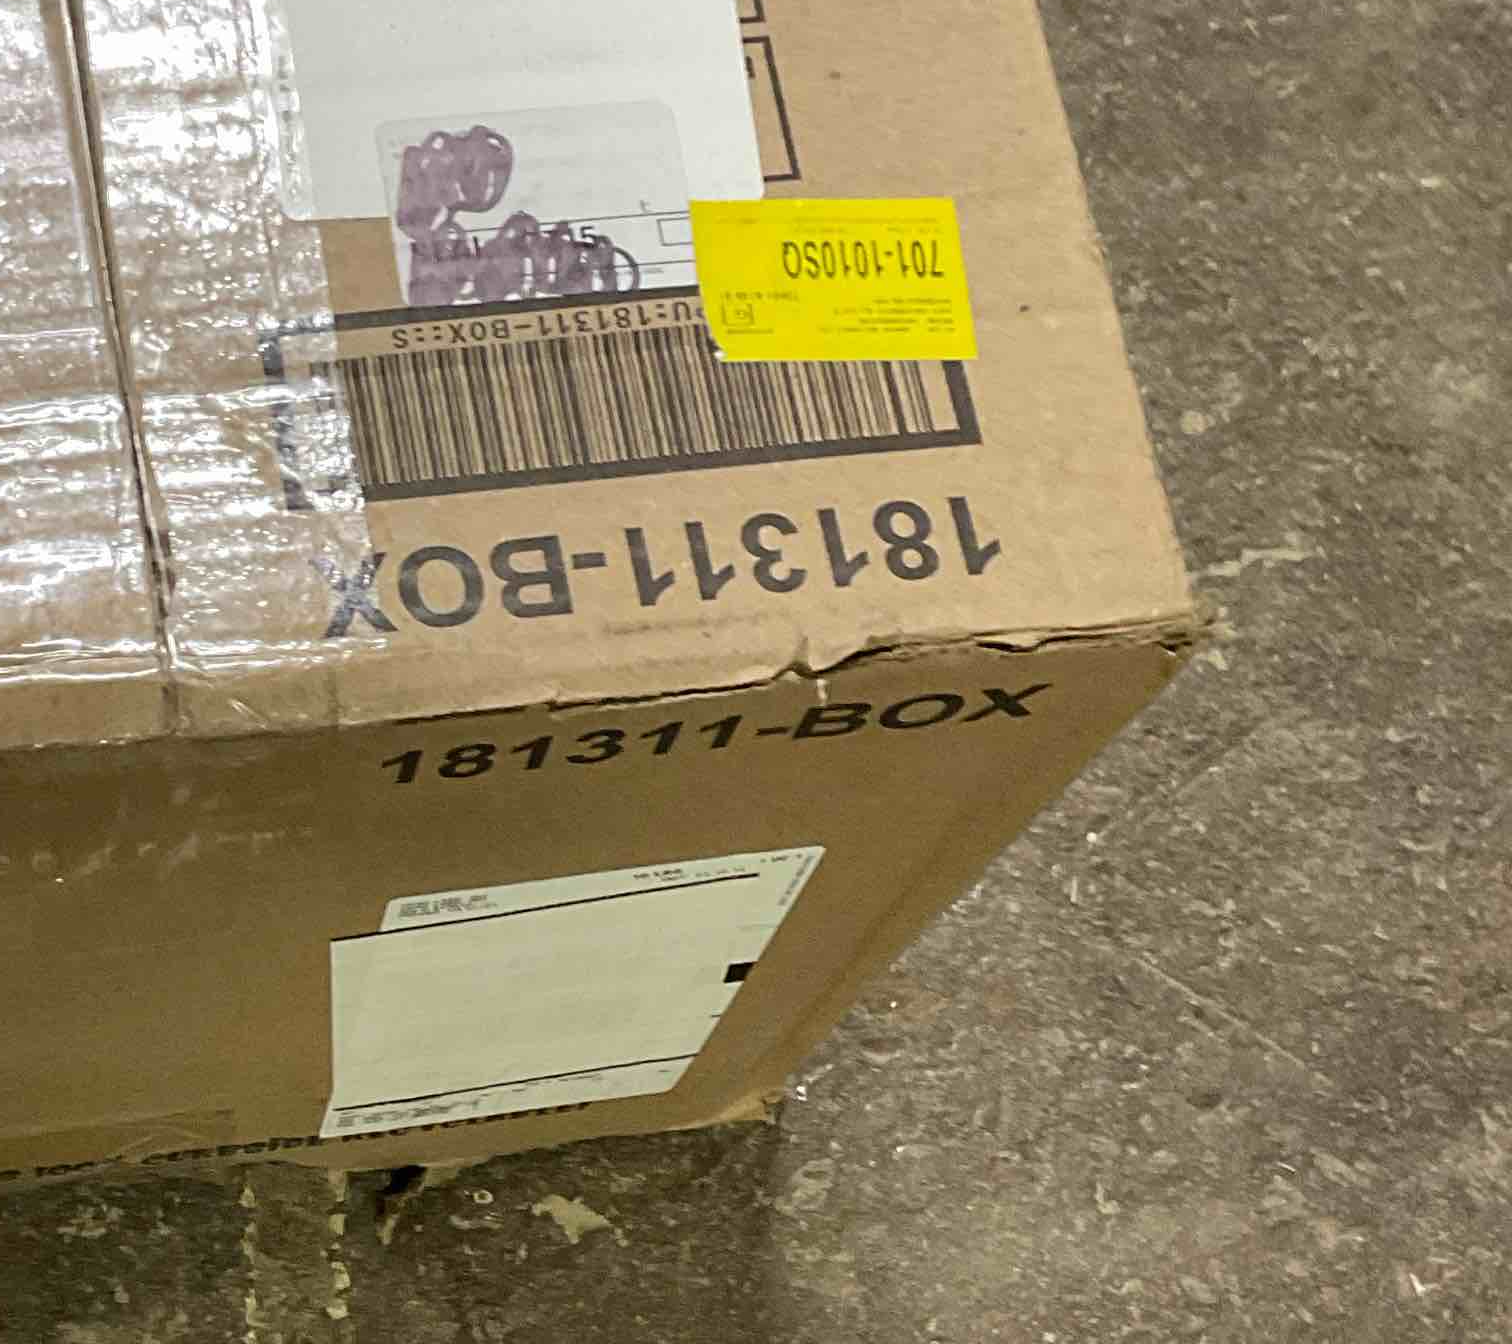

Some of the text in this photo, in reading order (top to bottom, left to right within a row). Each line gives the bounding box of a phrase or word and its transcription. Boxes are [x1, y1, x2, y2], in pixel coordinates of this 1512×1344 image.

[781, 240, 945, 279] 701-1010SQ
[318, 496, 1003, 640] 181311-BOX
[380, 682, 1053, 785] 181311-BOX
